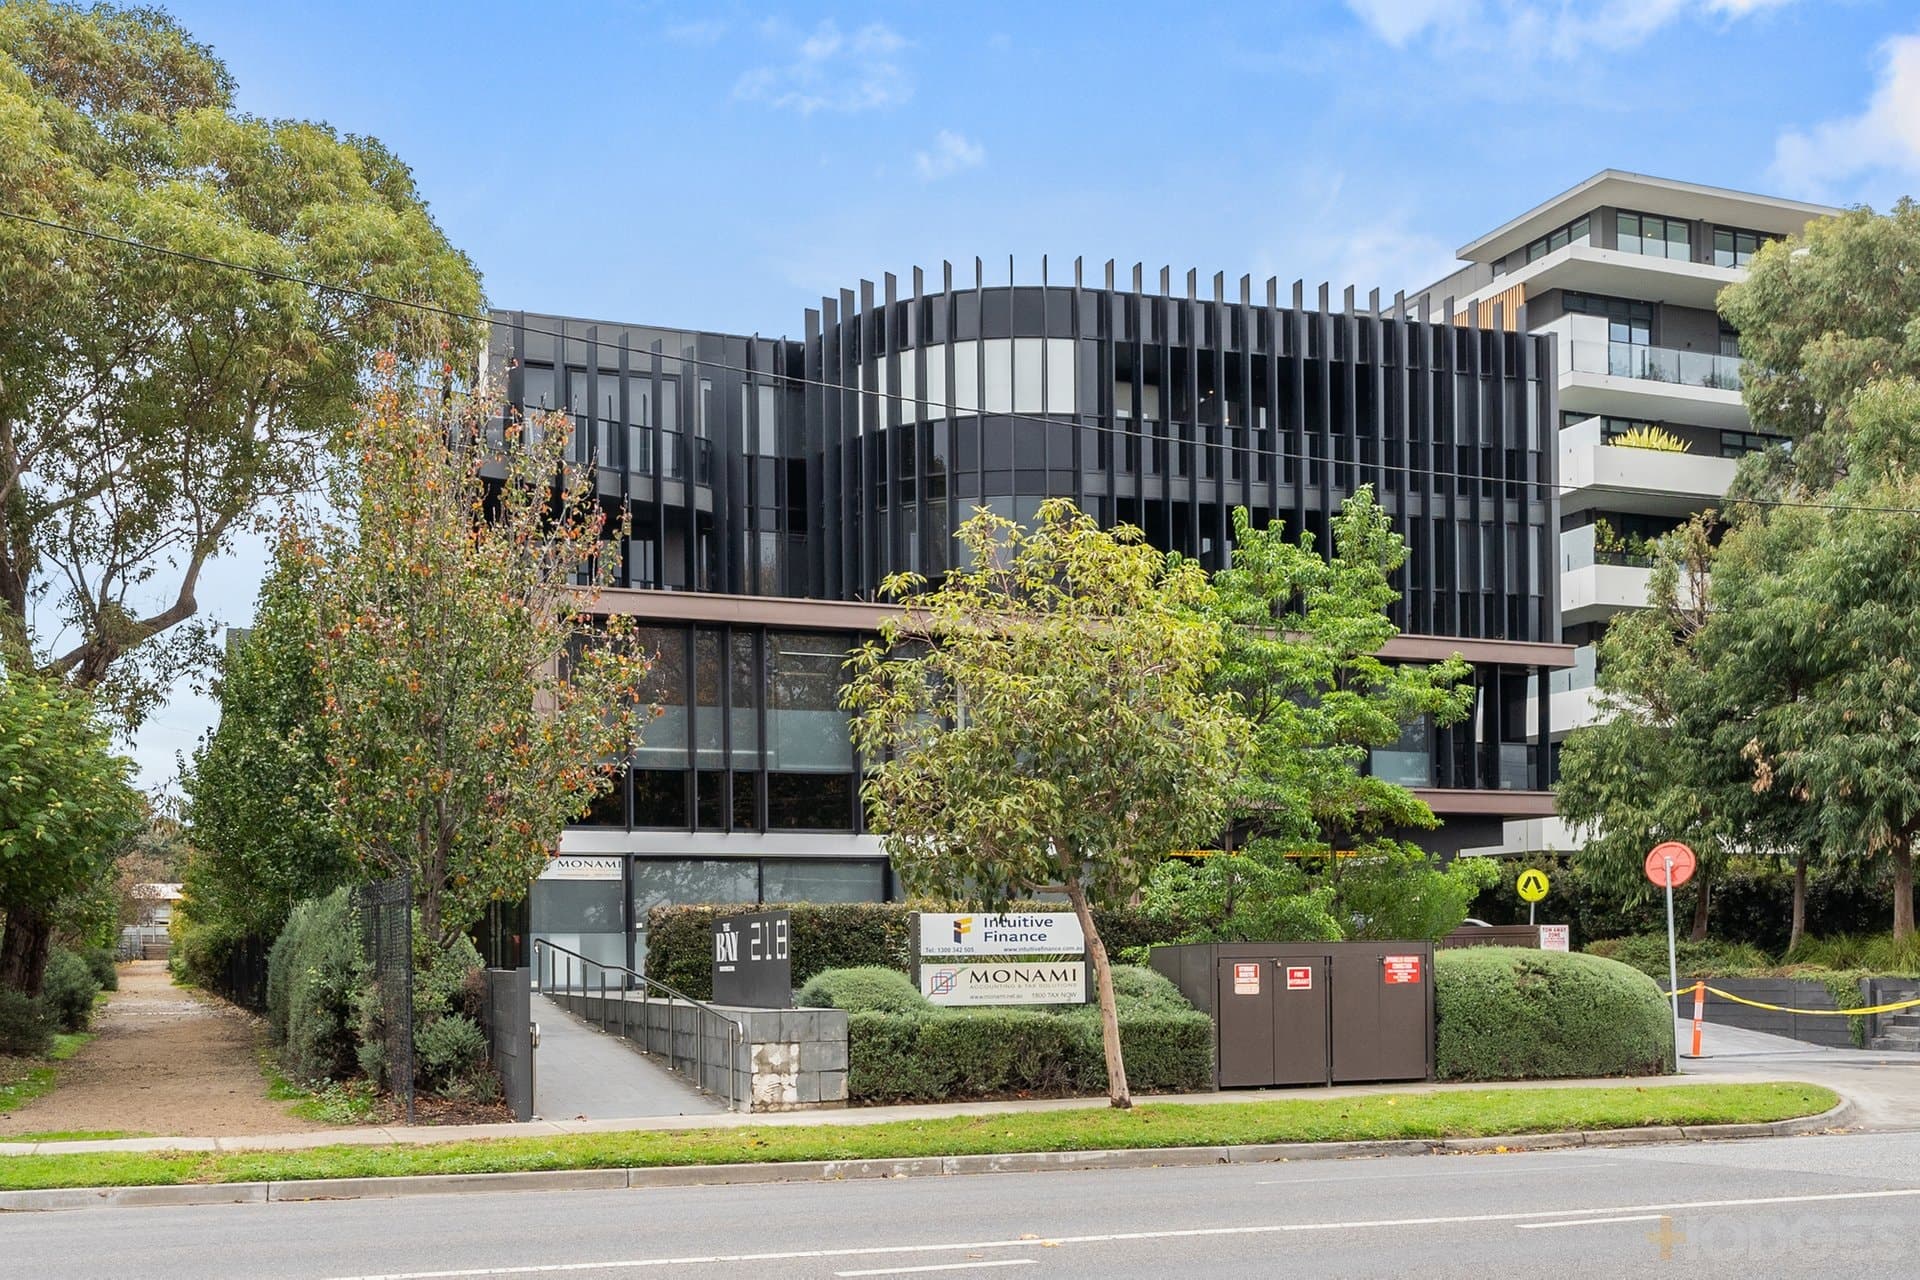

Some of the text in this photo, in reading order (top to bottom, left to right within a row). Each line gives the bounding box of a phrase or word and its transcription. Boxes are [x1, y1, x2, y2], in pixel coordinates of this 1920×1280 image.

[557, 859, 622, 868] MONAMI
[983, 916, 1054, 928] Intuitive
[751, 919, 788, 961] 218
[983, 931, 1048, 943] Finance
[715, 931, 739, 962] BAY
[969, 968, 1077, 984] MONAMI
